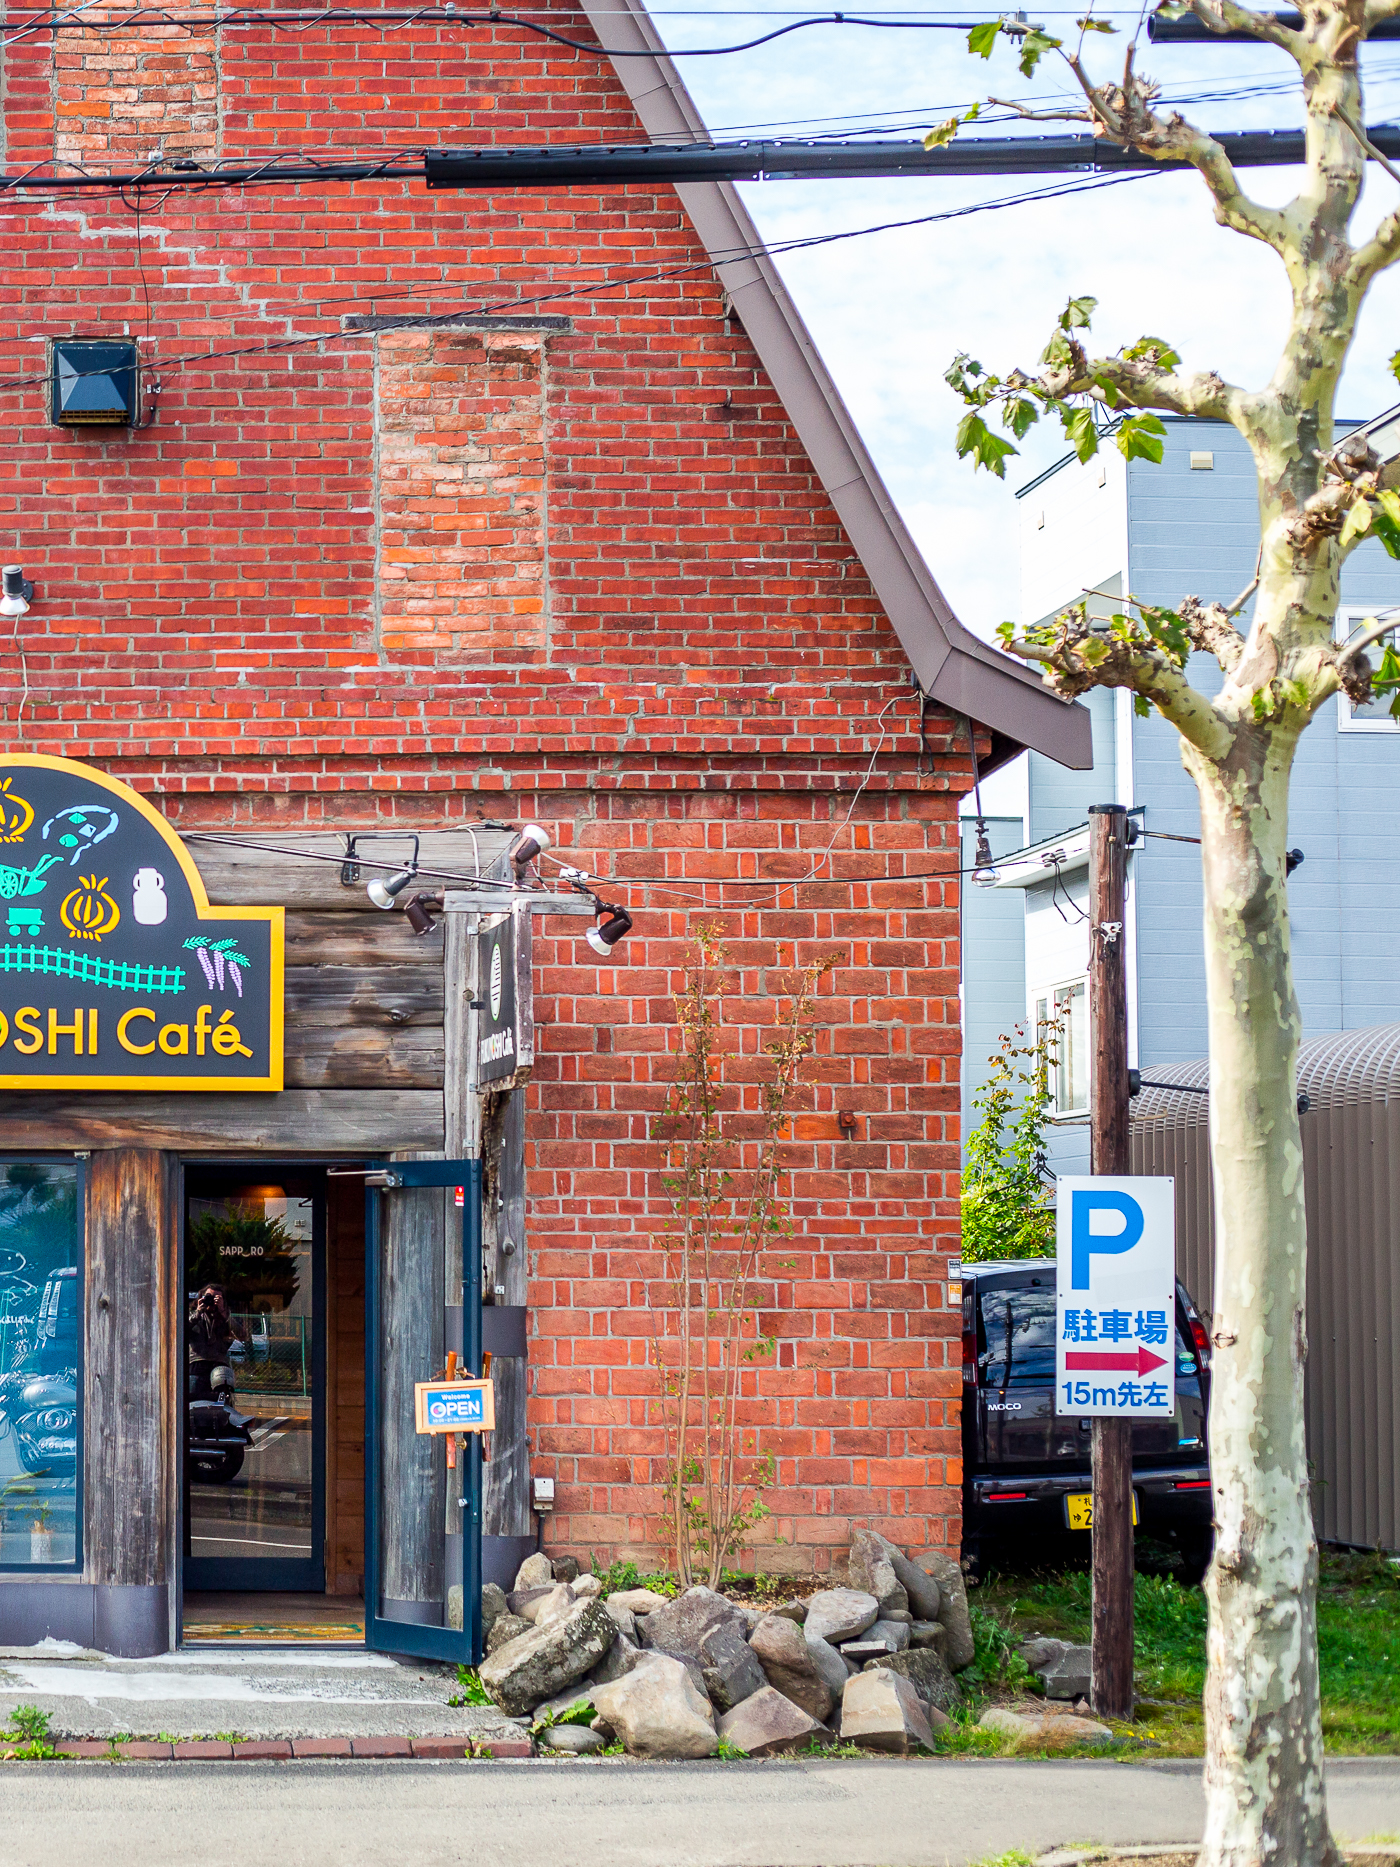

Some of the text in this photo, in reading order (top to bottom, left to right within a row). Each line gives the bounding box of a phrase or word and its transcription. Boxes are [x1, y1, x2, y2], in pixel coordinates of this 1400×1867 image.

[116, 1005, 255, 1059] Café
[1071, 1190, 1145, 1290] P
[1061, 1308, 1170, 1346] 駐車場
[441, 1393, 471, 1401] Welcome
[1061, 1380, 1170, 1408] 15m先左
[429, 1400, 481, 1419] OPEN
[987, 1402, 1022, 1411] MOCO
[1083, 1508, 1093, 1527] 2
